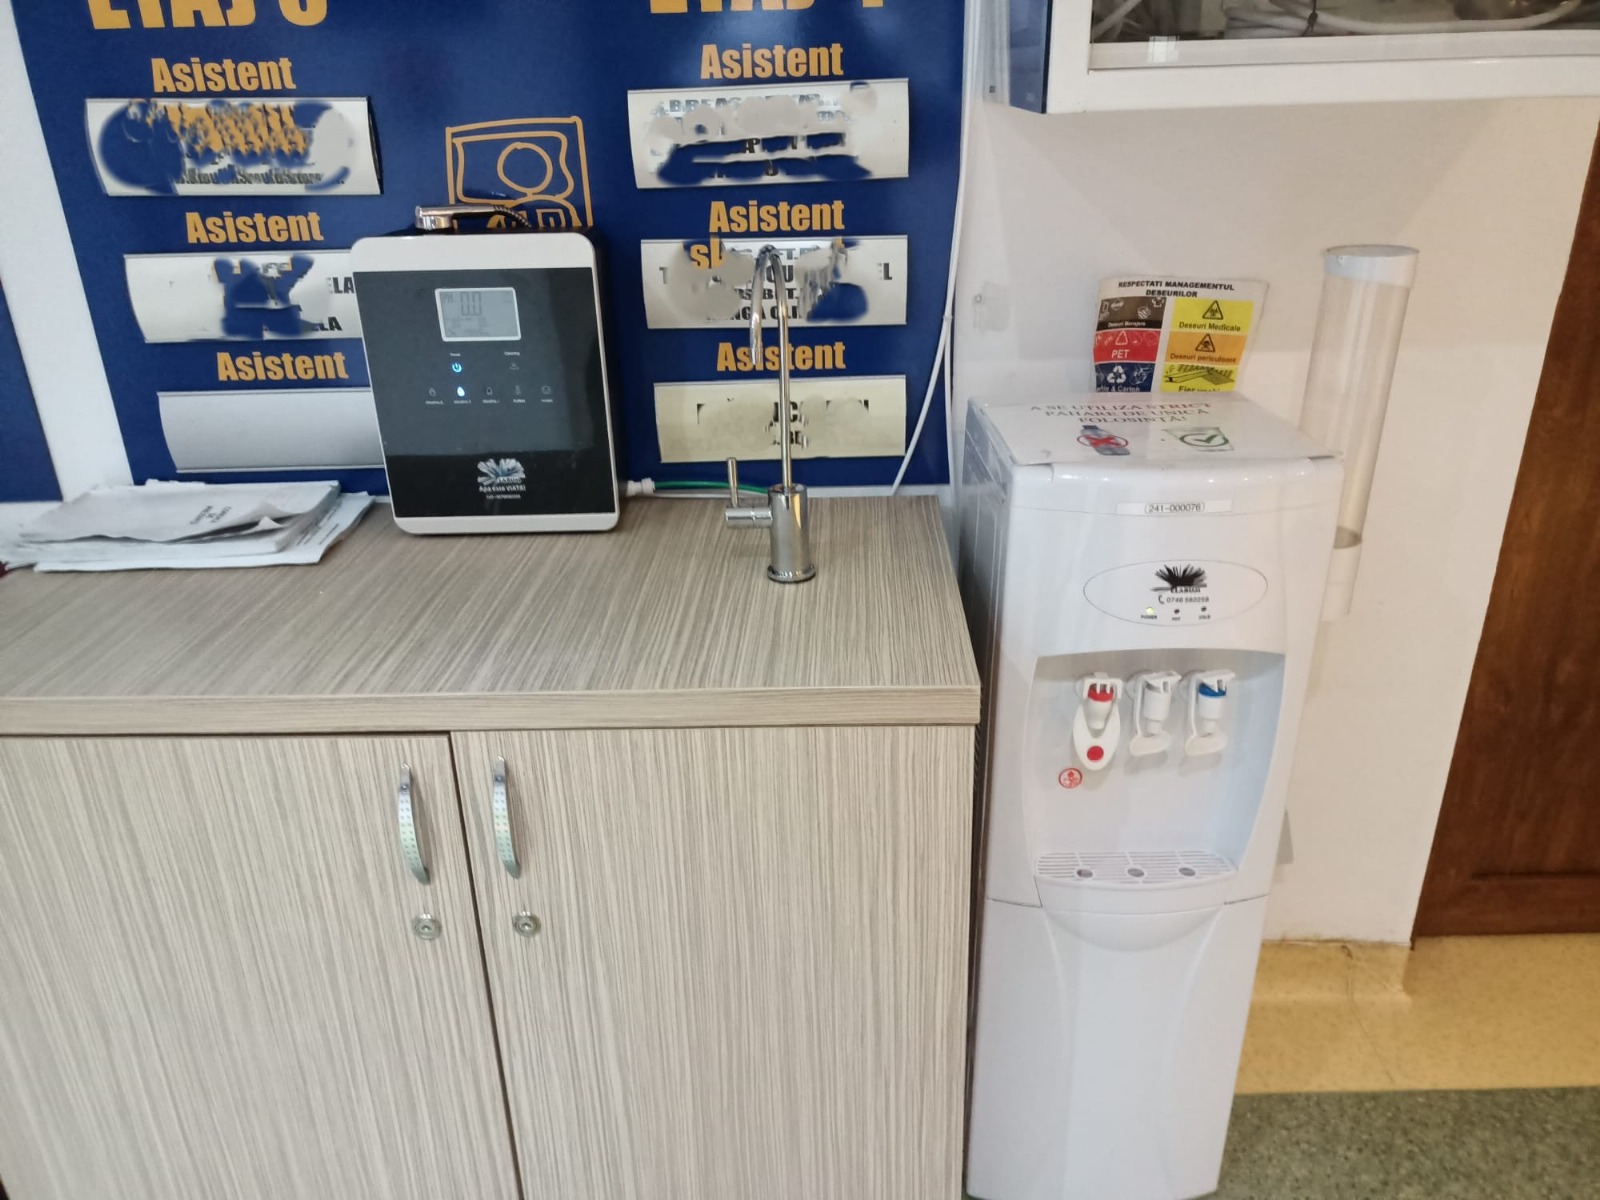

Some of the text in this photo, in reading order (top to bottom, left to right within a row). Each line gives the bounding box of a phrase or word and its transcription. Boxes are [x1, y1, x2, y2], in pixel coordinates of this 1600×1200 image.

[701, 43, 844, 80] Asistent
[151, 57, 296, 93] Asistent
[709, 200, 845, 233] Asistent
[185, 211, 325, 244] Asistent
[1118, 280, 1235, 291] RESPECTATI MANAGEMENTUL
[1145, 289, 1198, 298] DESEURILOR
[1179, 321, 1241, 332] Deseuri Medicale
[1111, 349, 1130, 359] PET
[1170, 352, 1237, 363] Deseuri periculoase
[217, 352, 349, 382] Asistent
[1145, 402, 1212, 410] STRICT
[1148, 503, 1201, 513] 241-000076
